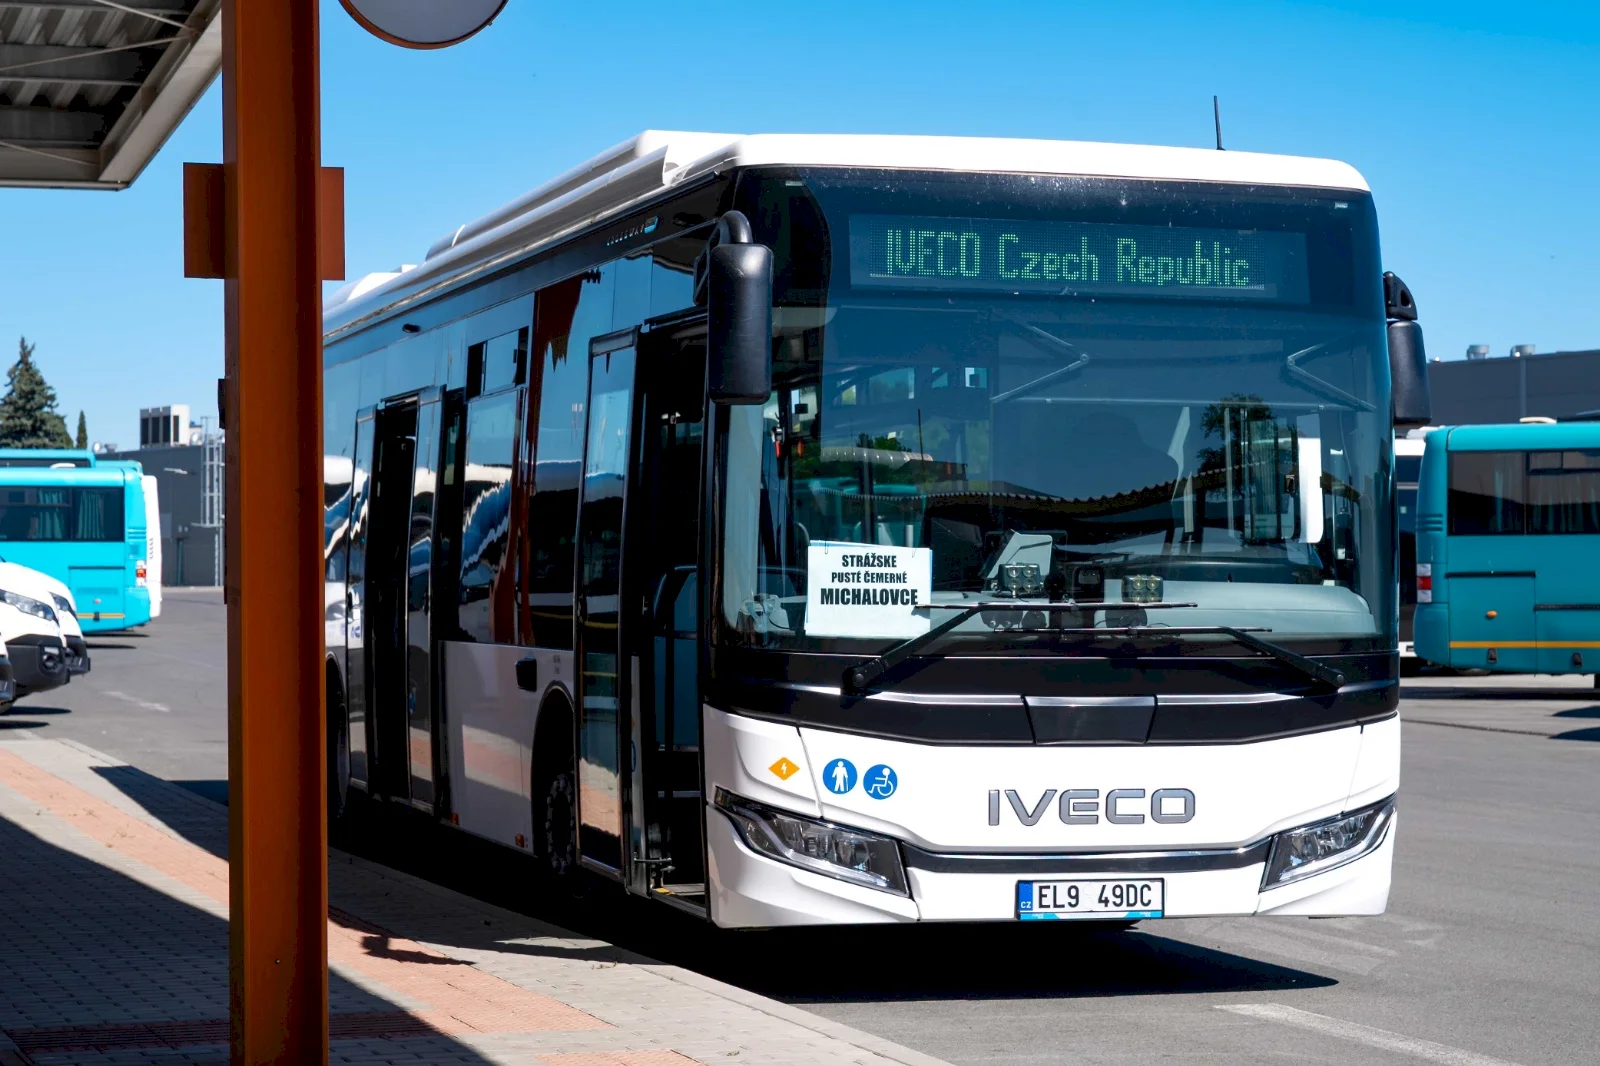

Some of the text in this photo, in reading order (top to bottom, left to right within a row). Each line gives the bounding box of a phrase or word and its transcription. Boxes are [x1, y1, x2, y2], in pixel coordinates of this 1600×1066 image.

[886, 229, 1250, 286] IVECO Czech Republic
[841, 553, 897, 568] STRÁŽSKE
[831, 570, 907, 584] PUSTÉ ČEMERNÉ
[820, 588, 918, 605] MICHALOVCE
[988, 788, 1196, 826] IVECO
[1038, 883, 1152, 909] EL9 49DC
[1020, 901, 1032, 909] CZ
